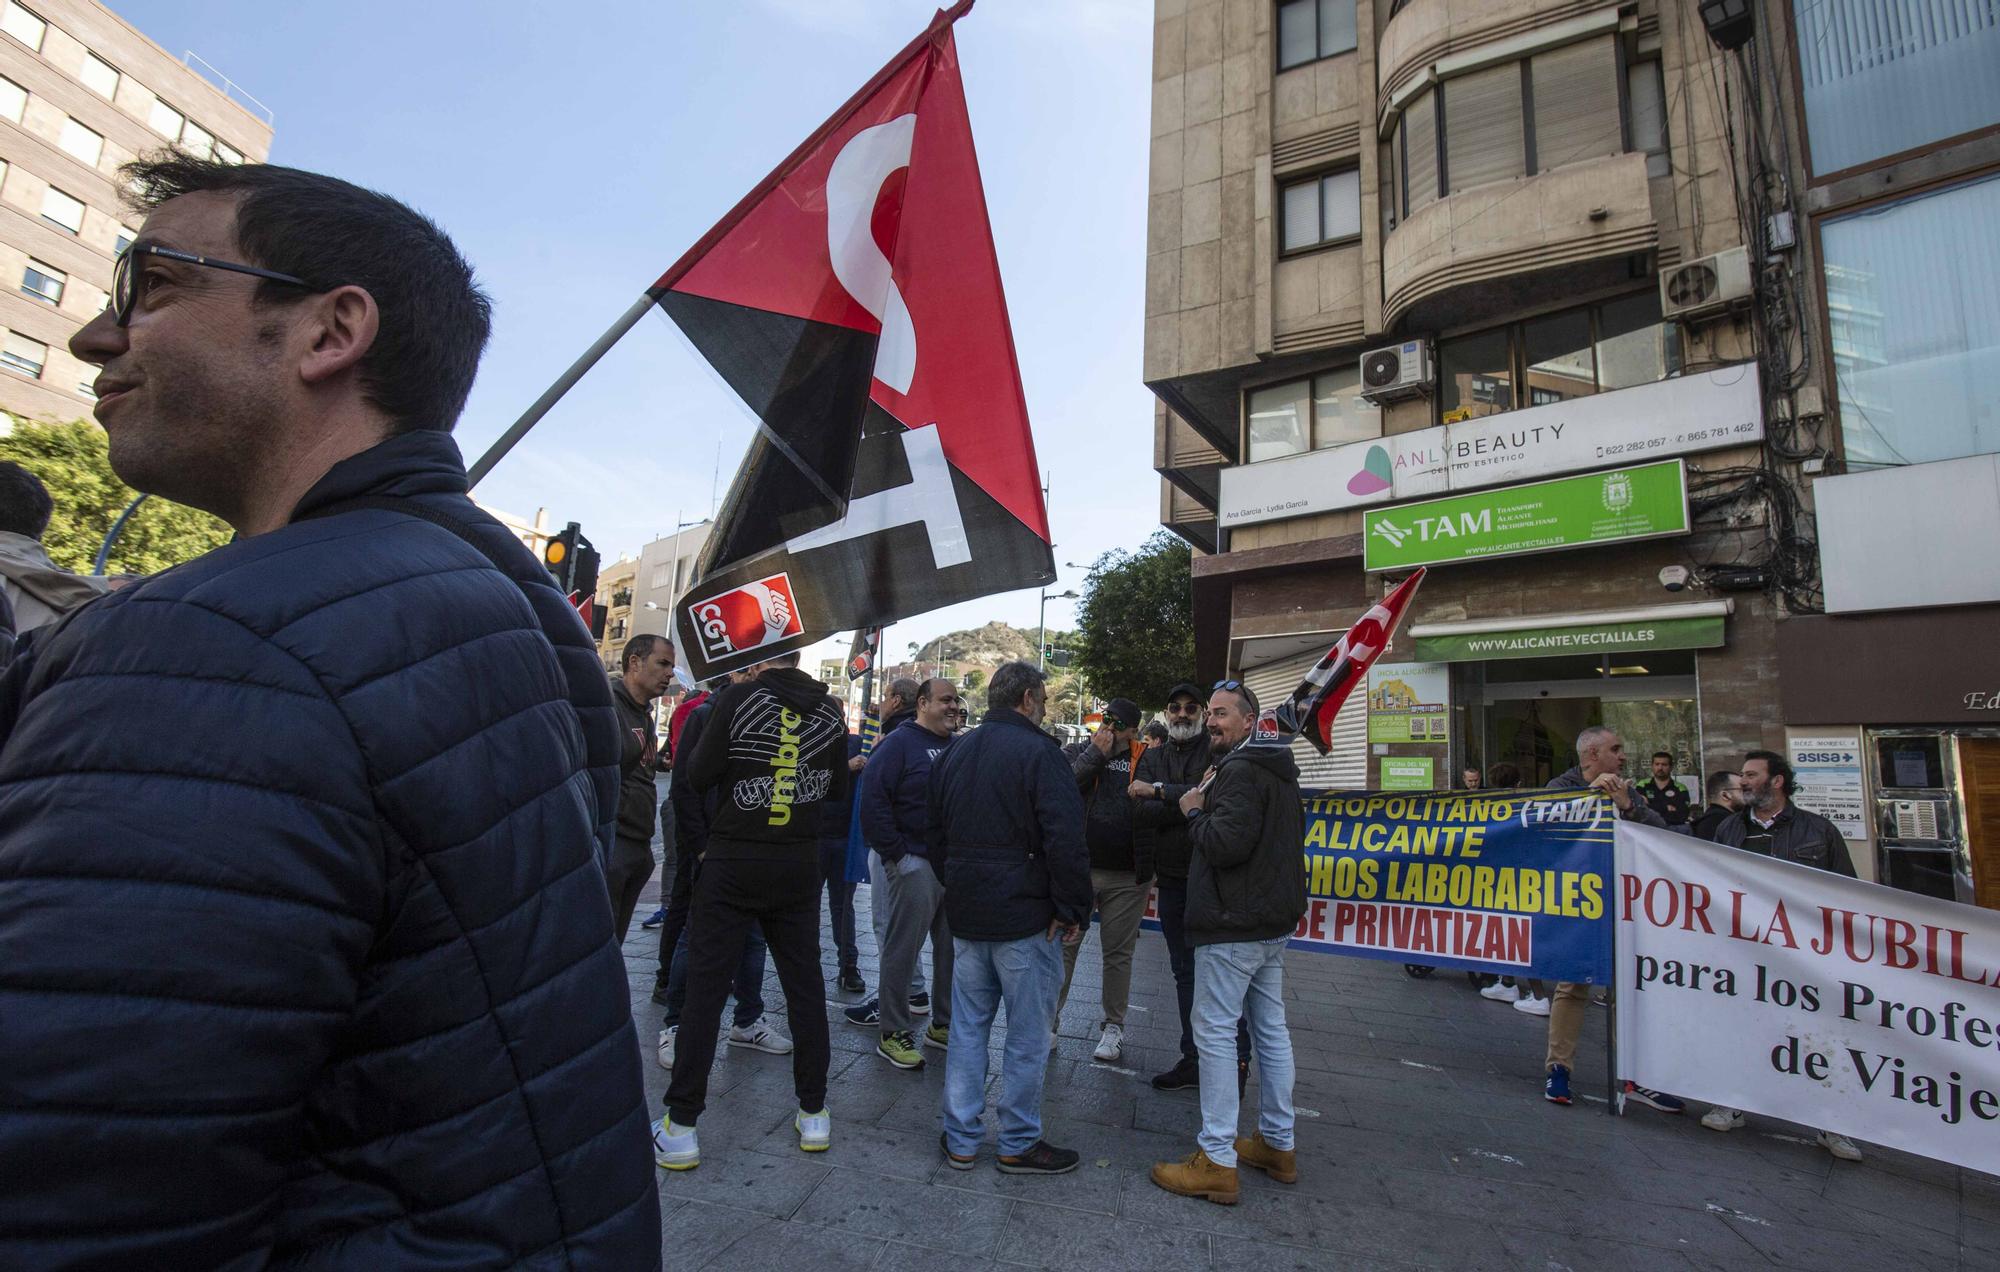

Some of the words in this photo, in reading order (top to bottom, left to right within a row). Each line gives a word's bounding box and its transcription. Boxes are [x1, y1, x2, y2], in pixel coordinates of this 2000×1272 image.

[1606, 446, 1624, 456] 622
[1626, 441, 1645, 452] 282
[1647, 437, 1667, 448] 057
[1687, 431, 1708, 442] 865
[1711, 427, 1729, 438] 781
[1733, 422, 1754, 433] 462
[1226, 511, 1239, 520] Ana
[1266, 503, 1285, 514] Lydia
[1413, 508, 1492, 542] TAM
[1465, 536, 1565, 556] WWW.ALICANTE.VECTALIA.ES
[699, 603, 733, 653] CGT
[1468, 629, 1656, 651] WWW.ALICANTE.VECTALIA.ES
[768, 706, 801, 826] umbro
[1797, 752, 1840, 762] asisa
[1520, 795, 1602, 830] (TAM)
[1304, 819, 1487, 859] ALICANTE
[1385, 860, 1604, 920] LABORABLES
[1619, 873, 1716, 935] POR
[1727, 889, 1800, 950] LA
[1334, 902, 1531, 964] PRIVATIZAN
[1634, 953, 1738, 996] para
[1753, 963, 1821, 1013] los
[1770, 1035, 1829, 1081] de
[1846, 1047, 1999, 1125] Viaje
